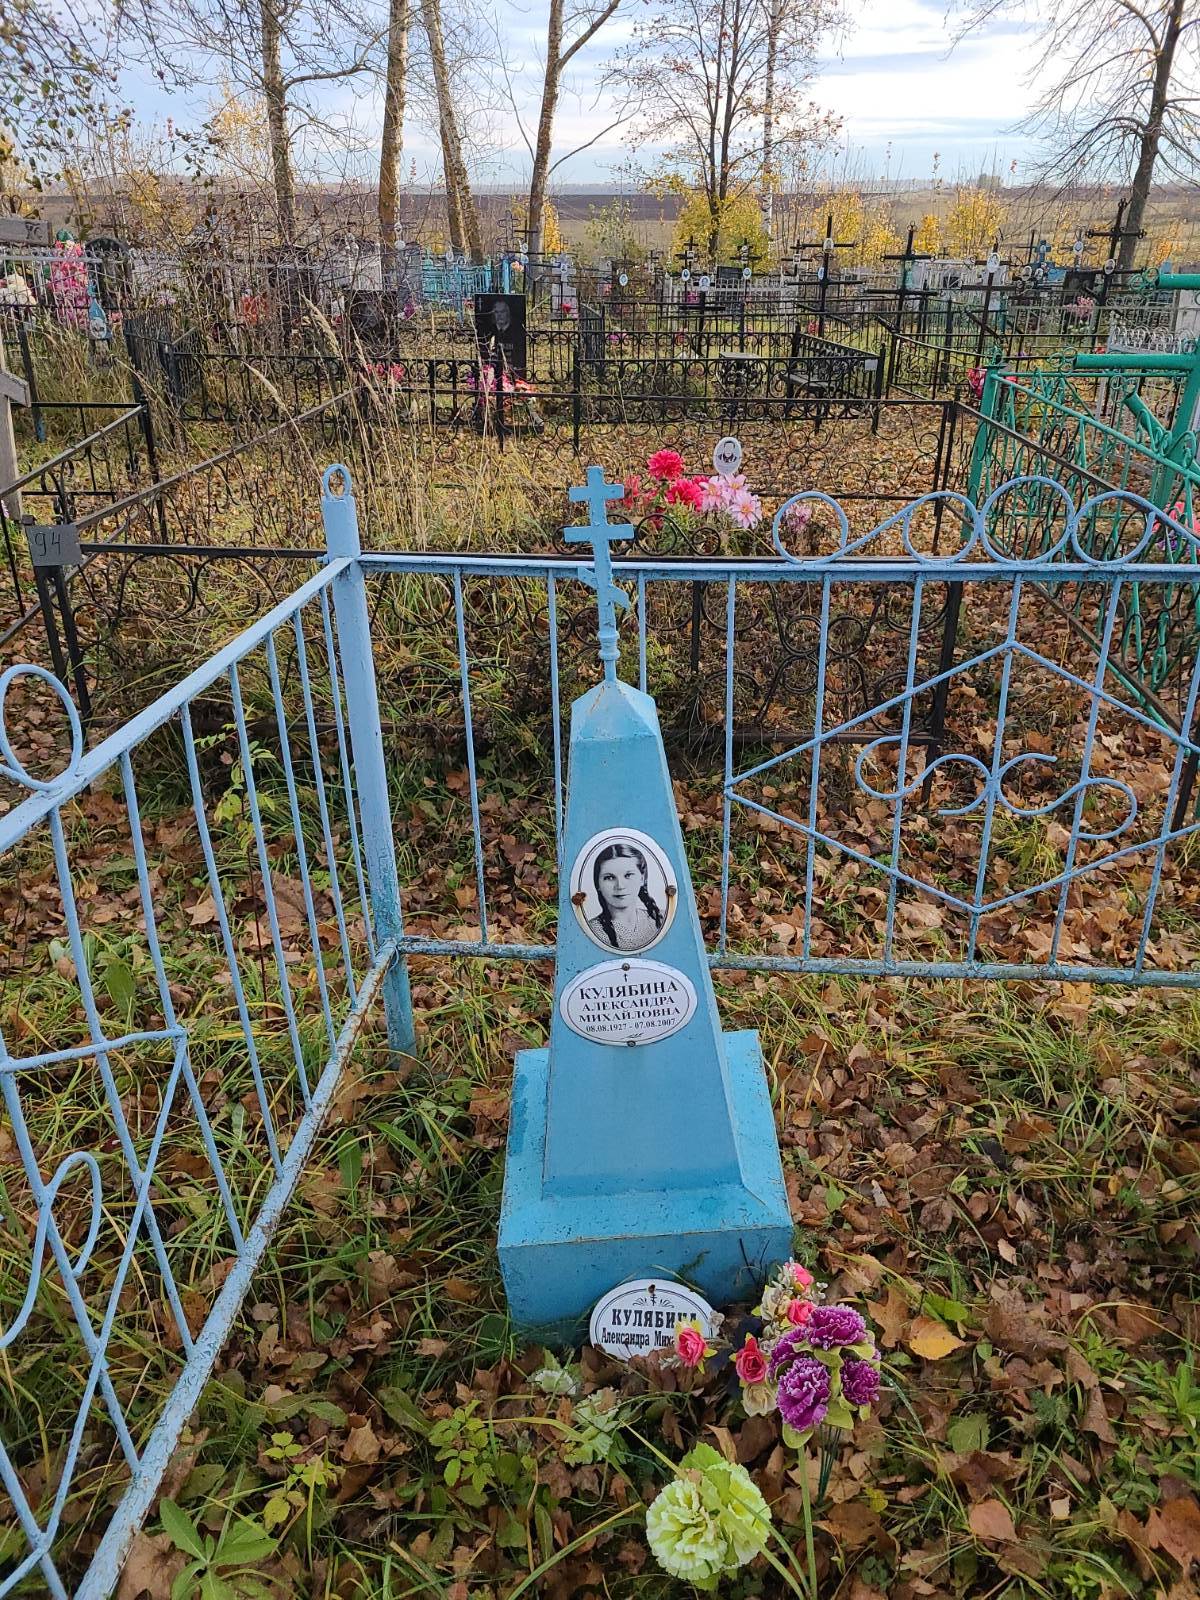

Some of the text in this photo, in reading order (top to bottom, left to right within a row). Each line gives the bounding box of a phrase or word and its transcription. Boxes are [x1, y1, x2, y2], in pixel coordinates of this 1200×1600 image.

[34, 531, 61, 567] 94
[580, 980, 678, 1000] КУЛЯБИНА
[582, 995, 675, 1012] АЛЕКСАНДРА
[578, 1007, 681, 1023] МИХАЙЛОВНА
[586, 1023, 627, 1033] 08.08.1927
[634, 1018, 676, 1030] 07.08.2007
[601, 1327, 650, 1349] Александра
